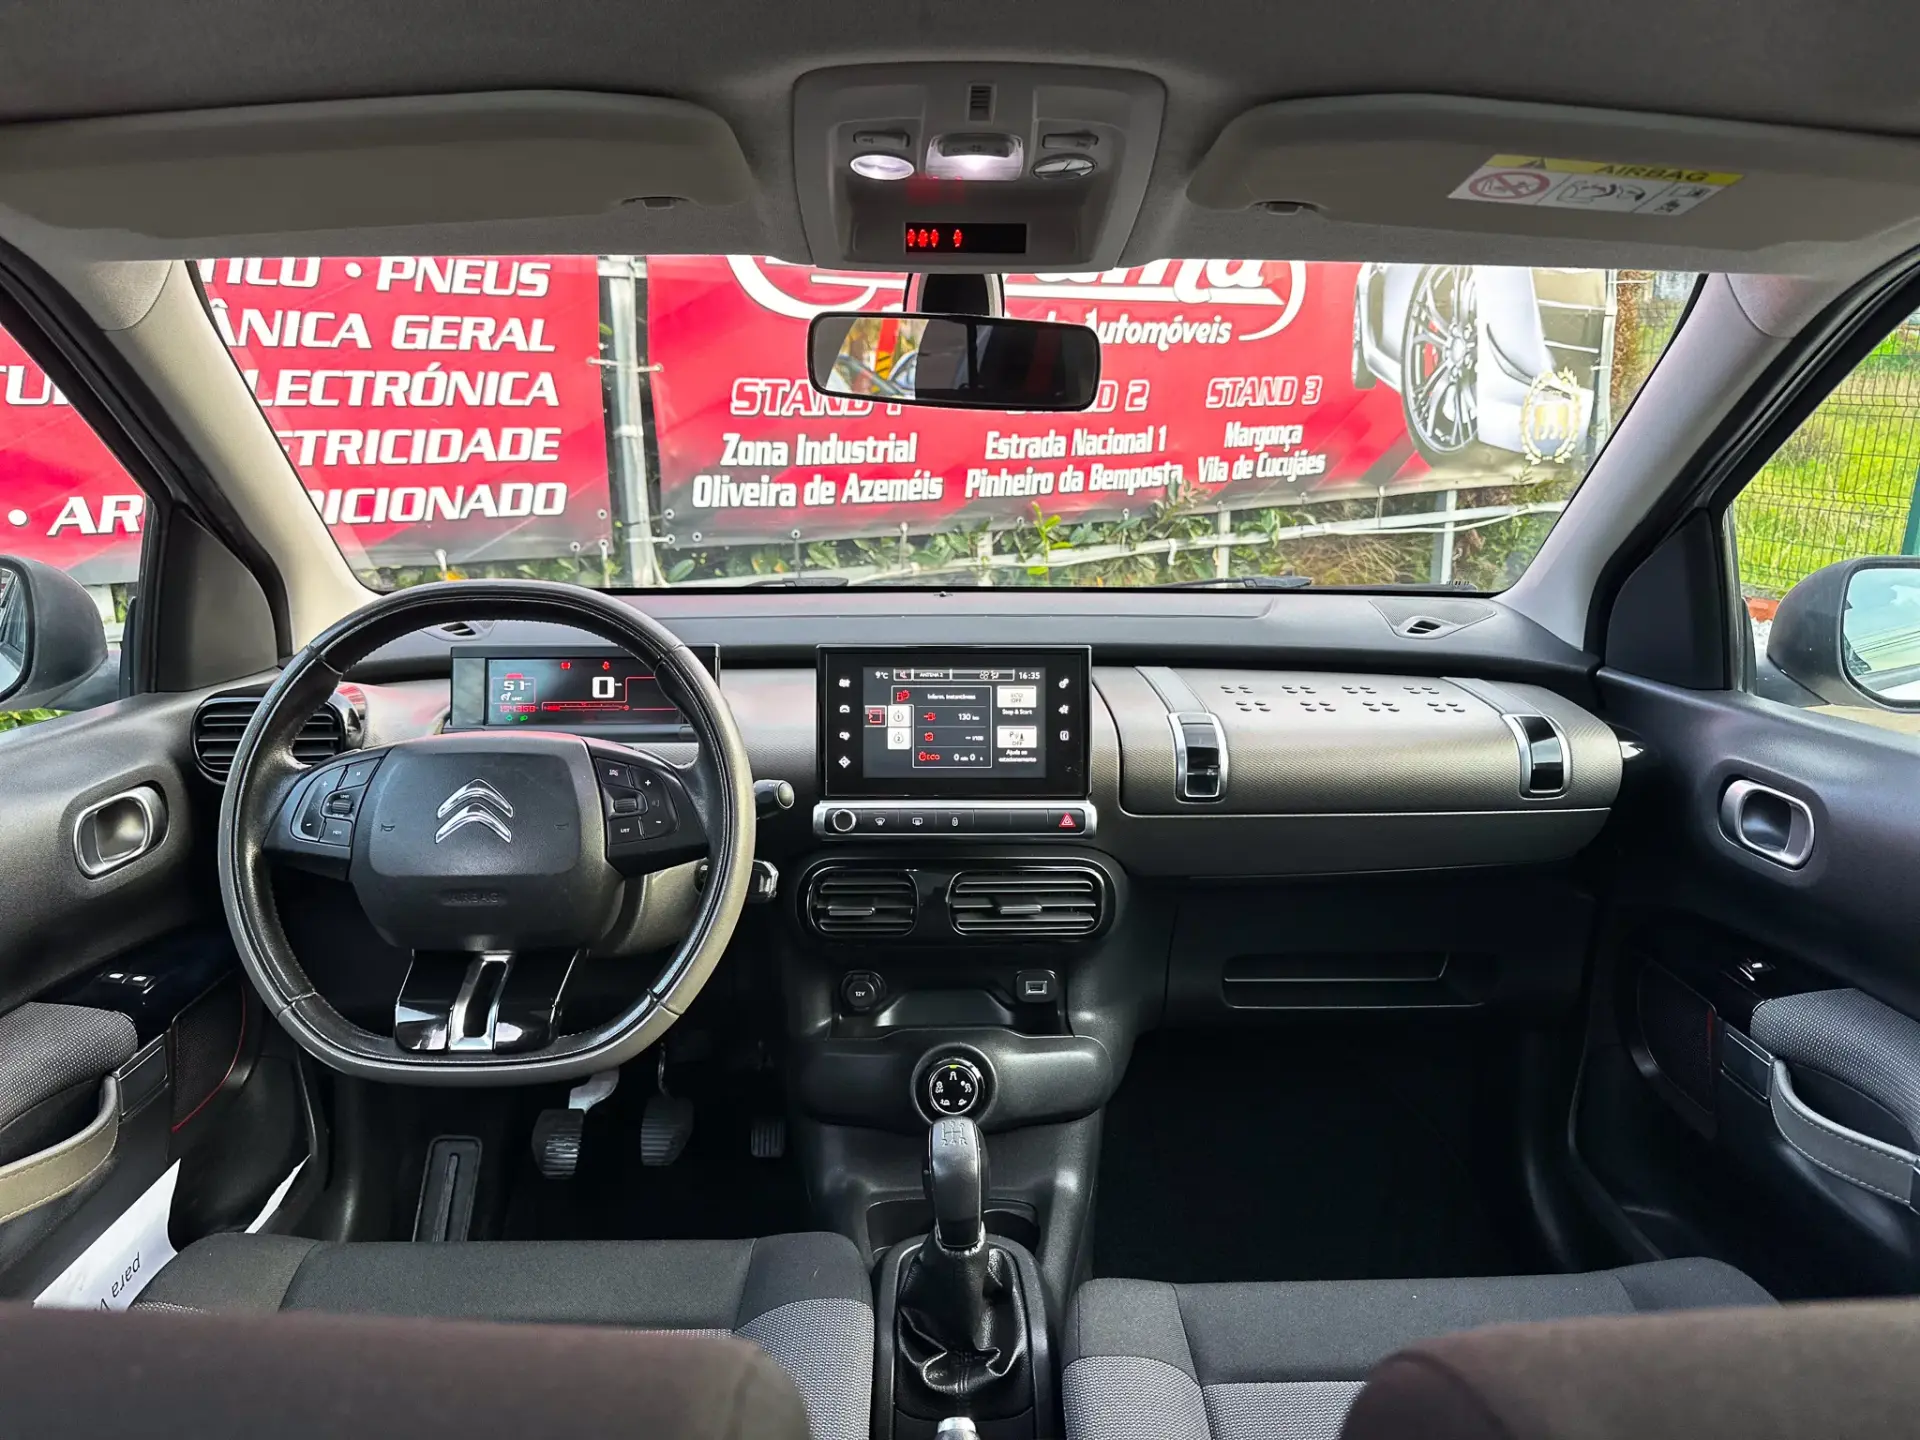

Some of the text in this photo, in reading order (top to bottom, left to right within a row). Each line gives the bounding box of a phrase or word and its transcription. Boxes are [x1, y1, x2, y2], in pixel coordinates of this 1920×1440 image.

[1594, 165, 1709, 182] AIRBAG
[376, 257, 551, 297] PNEUS
[391, 314, 556, 352] GERAL
[1124, 379, 1150, 412] 2
[1205, 375, 1323, 408] STAND 3
[720, 432, 918, 466] Zona Industrial
[985, 425, 1168, 460] Estrada Nacional 1
[1224, 421, 1303, 452] Margonça
[965, 461, 1184, 498] Pinheiro da Bemposta
[1198, 456, 1229, 483] Vila
[1232, 454, 1254, 480] de
[693, 469, 944, 508] Oliveira de Azeméis
[46, 494, 144, 537] AR
[592, 676, 615, 698] 0
[1018, 671, 1041, 680] 16:35
[958, 713, 971, 721] 130
[111, 1251, 140, 1298] para
